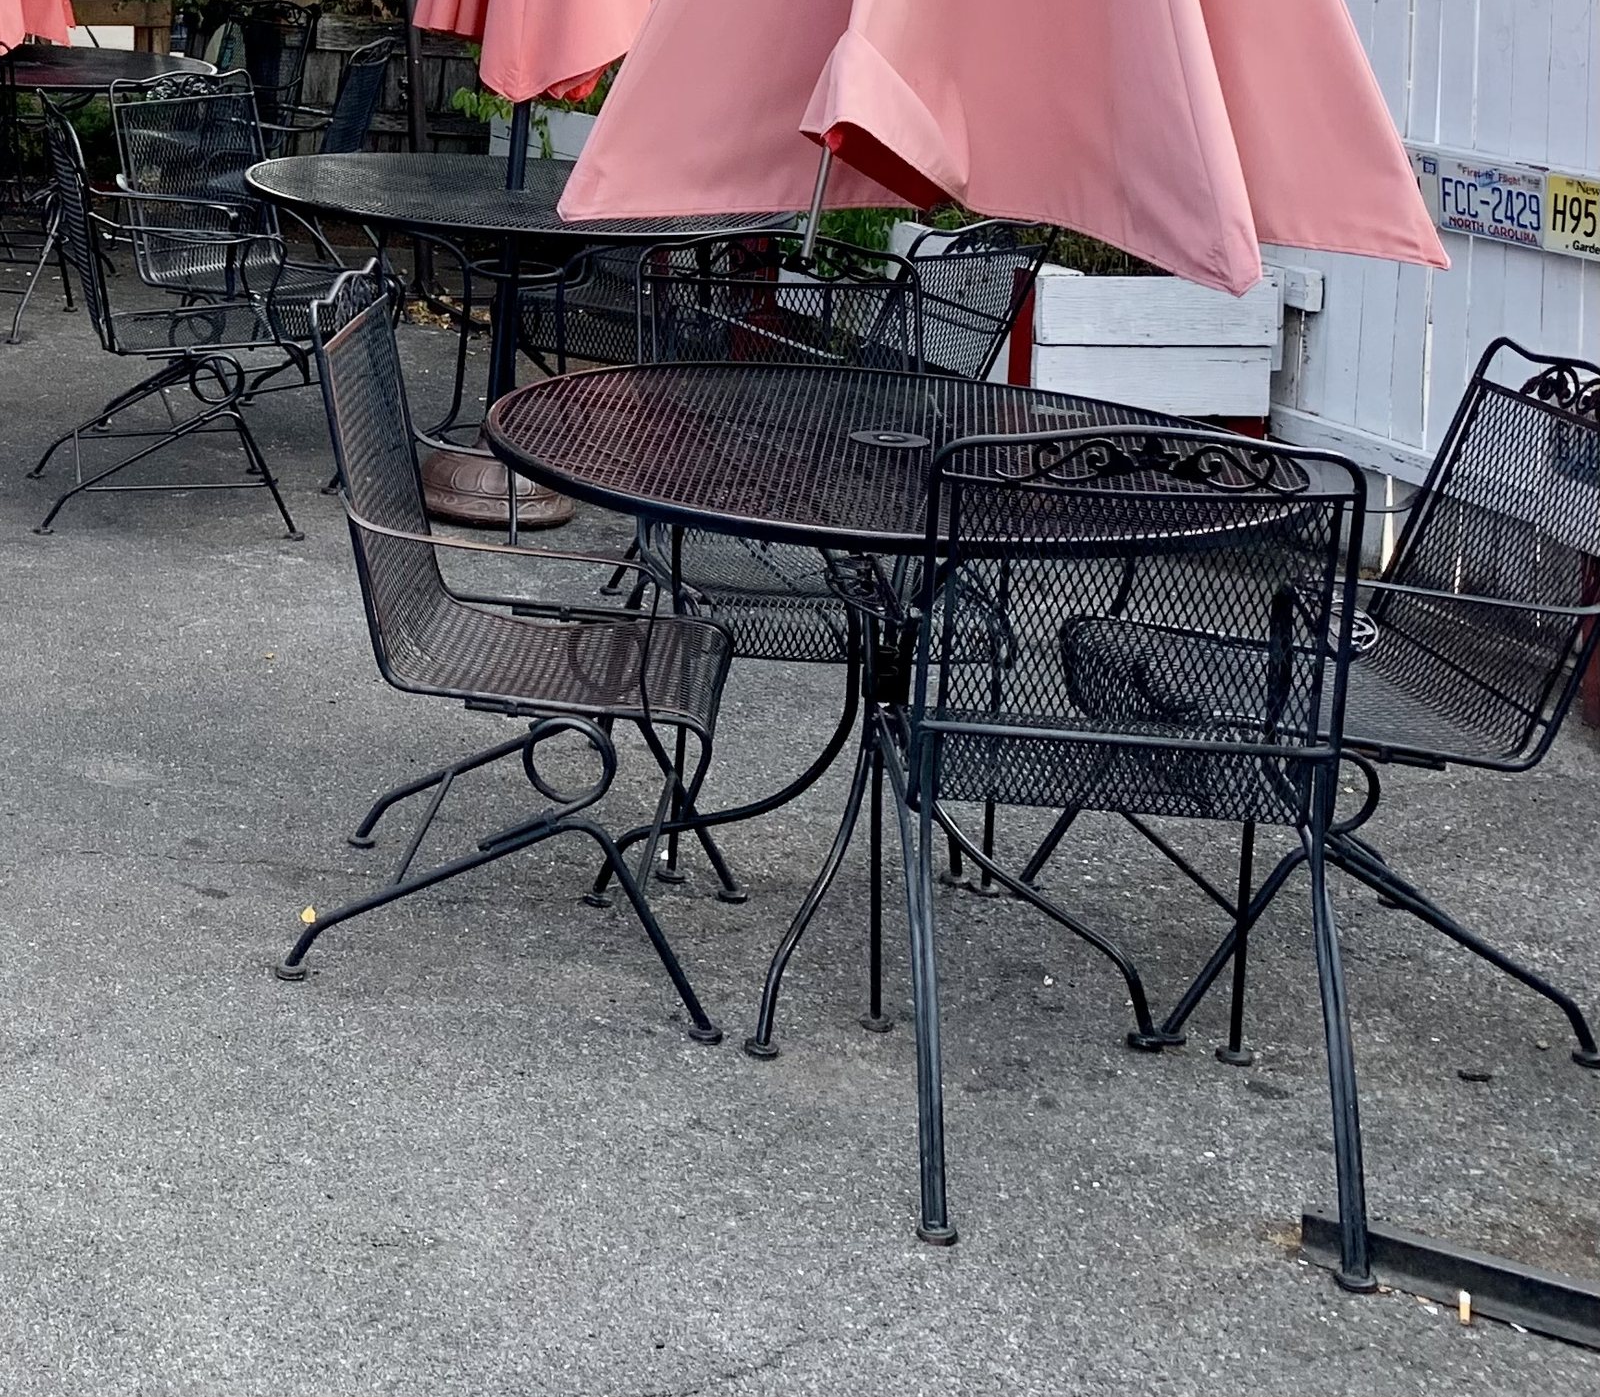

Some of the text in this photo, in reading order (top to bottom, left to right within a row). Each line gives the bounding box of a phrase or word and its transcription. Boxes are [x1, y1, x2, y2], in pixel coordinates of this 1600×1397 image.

[1577, 180, 1600, 196] New
[1442, 177, 1540, 231] FCC-2429
[1448, 216, 1537, 243] NORTH CAROLINA
